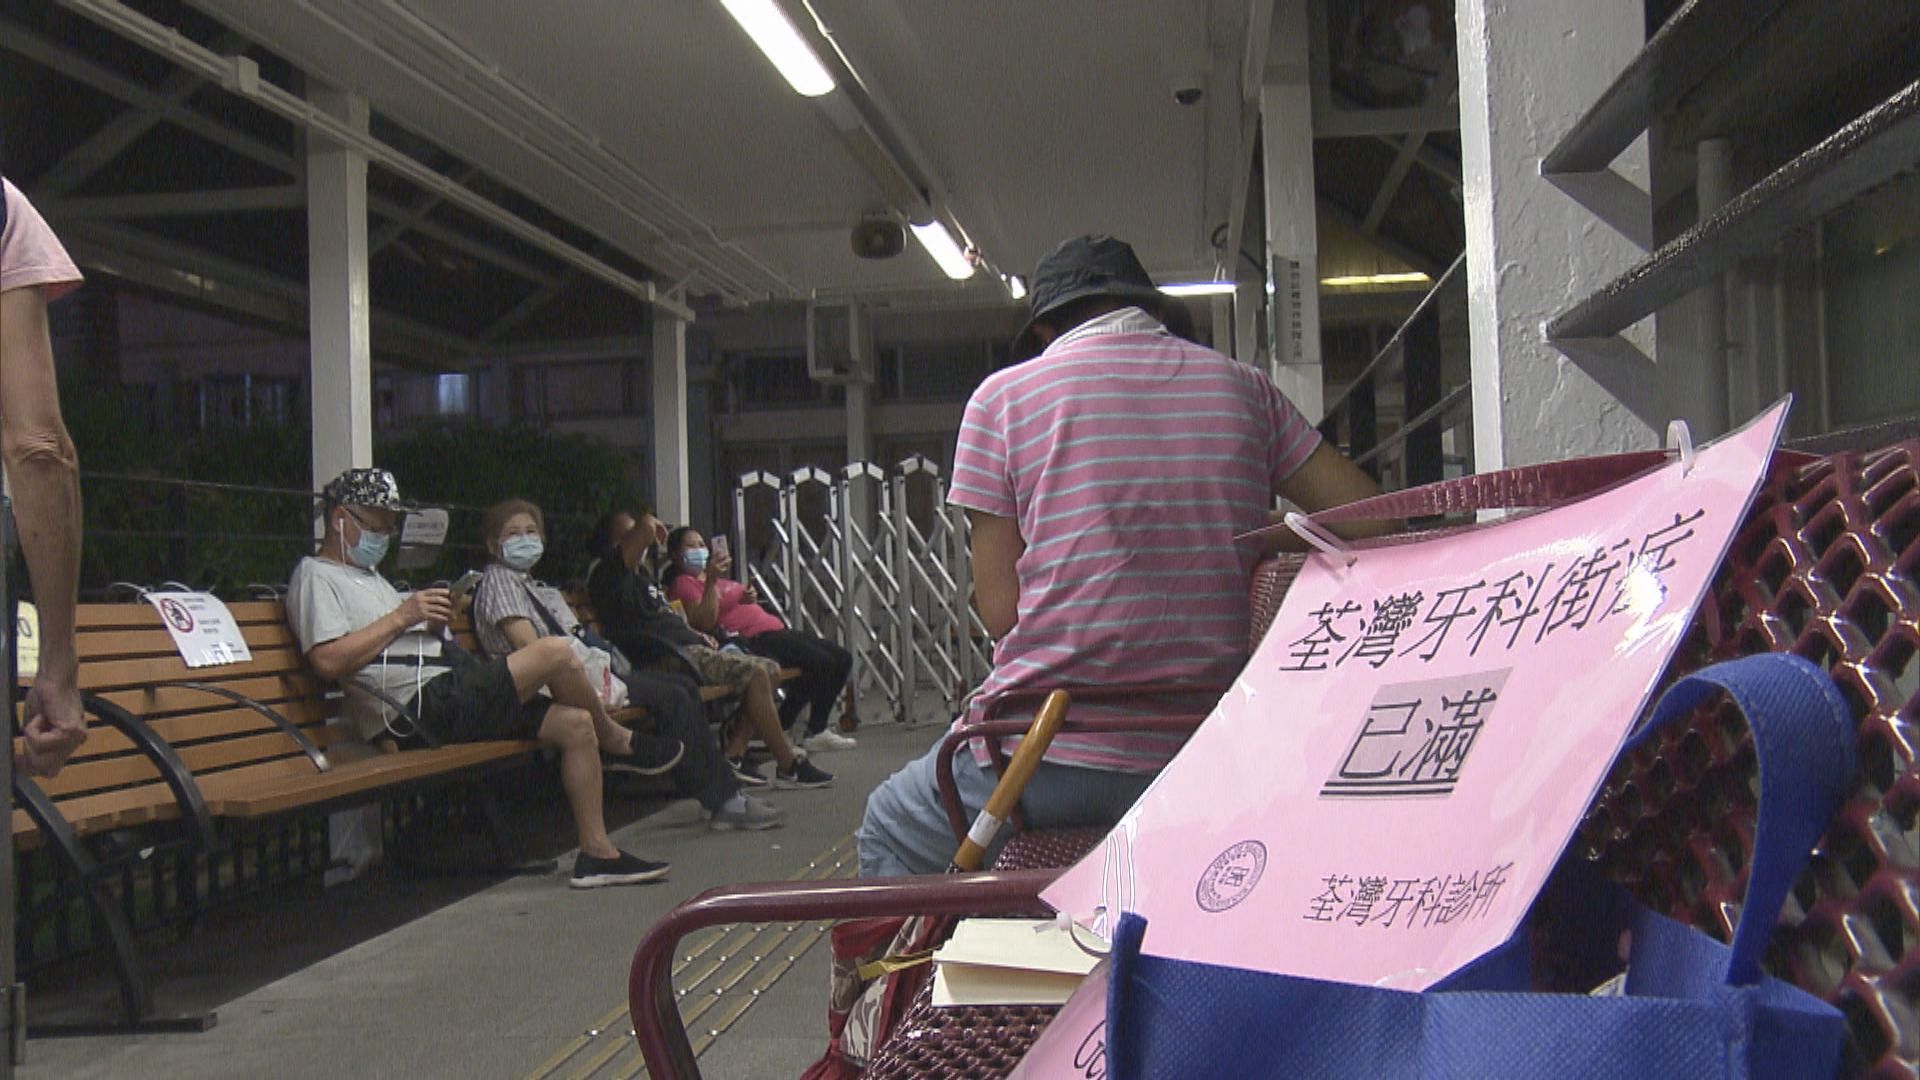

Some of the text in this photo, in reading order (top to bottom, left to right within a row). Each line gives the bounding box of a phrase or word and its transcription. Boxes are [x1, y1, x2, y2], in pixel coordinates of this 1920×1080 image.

[1339, 687, 1498, 783] 已滿
[1302, 861, 1515, 930] 荃灣牙科診所
